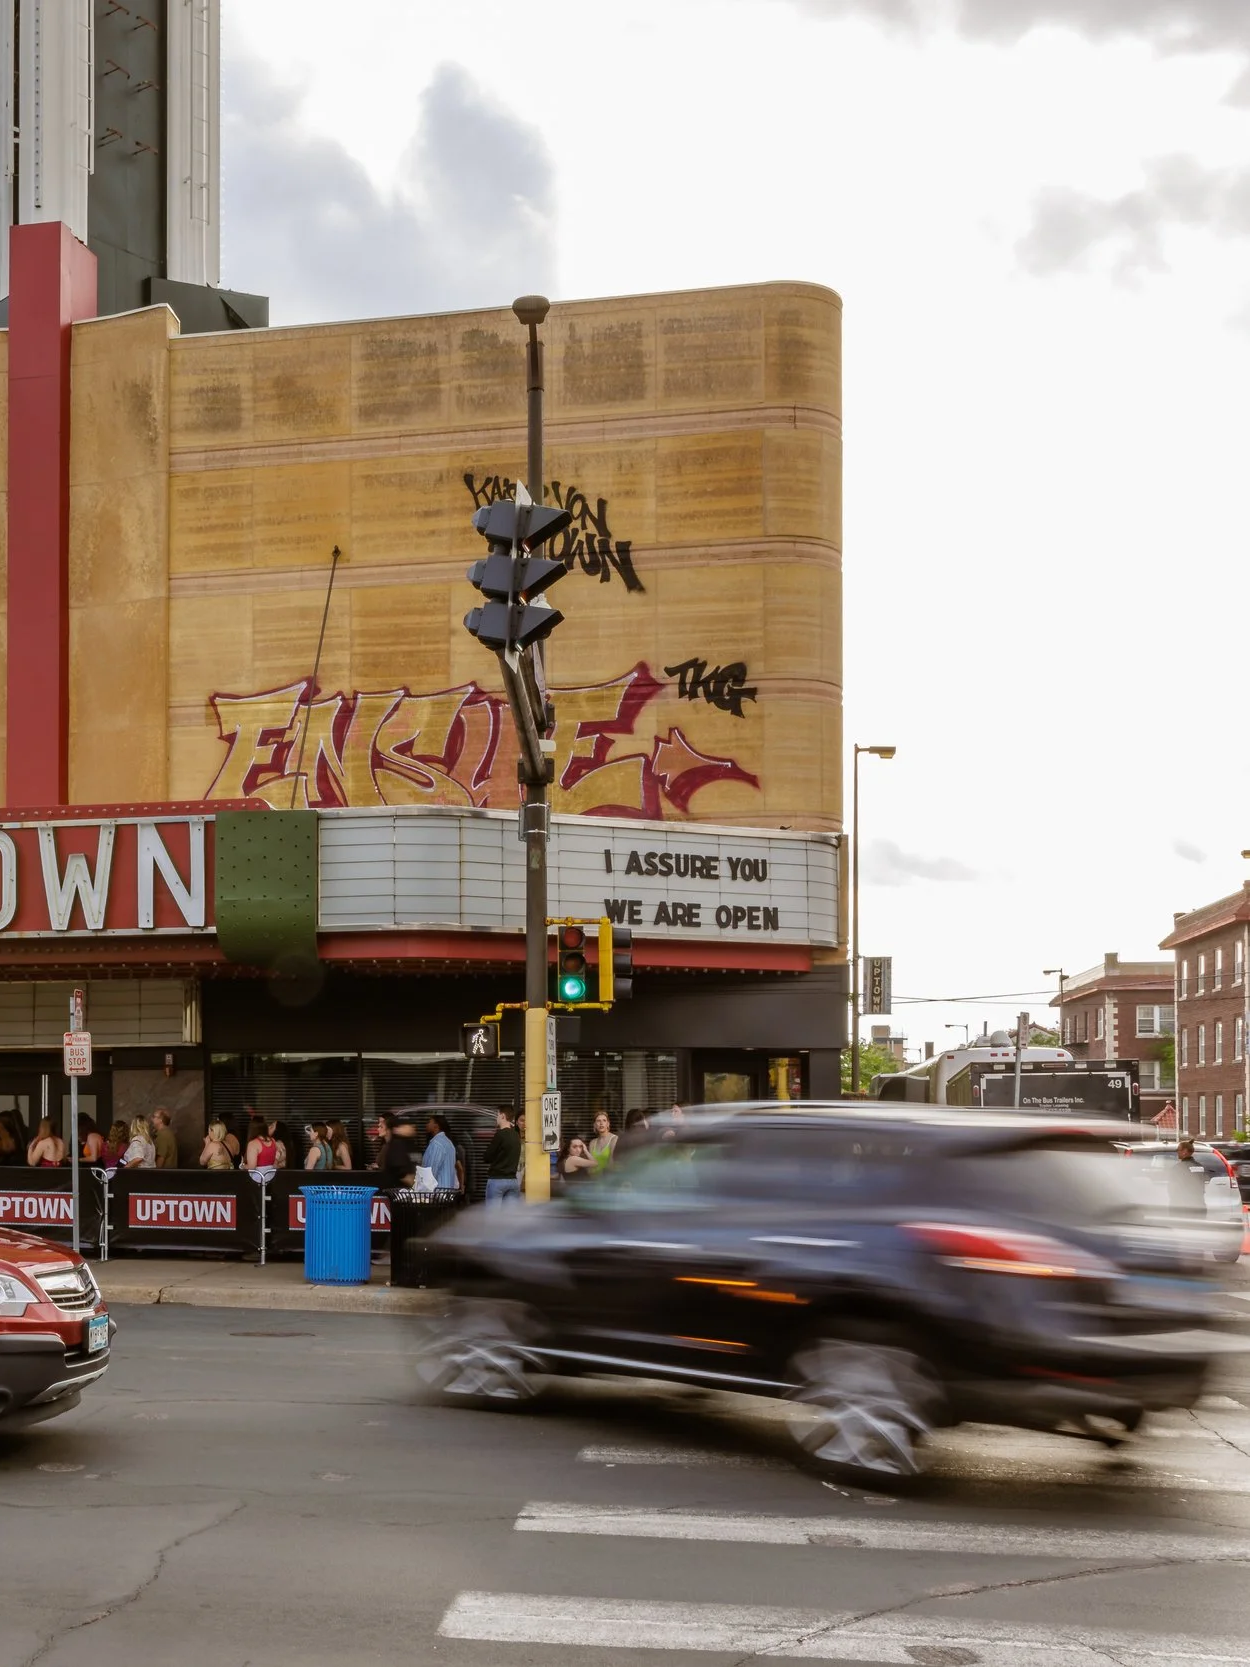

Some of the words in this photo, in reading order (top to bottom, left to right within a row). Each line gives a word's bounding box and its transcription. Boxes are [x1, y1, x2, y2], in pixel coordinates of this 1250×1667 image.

[604, 849, 612, 873] I
[625, 850, 719, 880] ASSURE
[727, 856, 768, 882] YOU
[604, 899, 643, 925] WE
[653, 901, 702, 927] ARE
[715, 905, 779, 931] OPEN
[873, 960, 881, 1013] UPTOWN
[70, 1048, 85, 1057] BUS
[68, 1057, 87, 1066] STOP
[1107, 1079, 1122, 1088] 49
[543, 1097, 558, 1111] ONE
[1054, 1096, 1074, 1104] Trailers
[543, 1113, 559, 1127] WAY
[136, 1199, 231, 1223] UPTOWN
